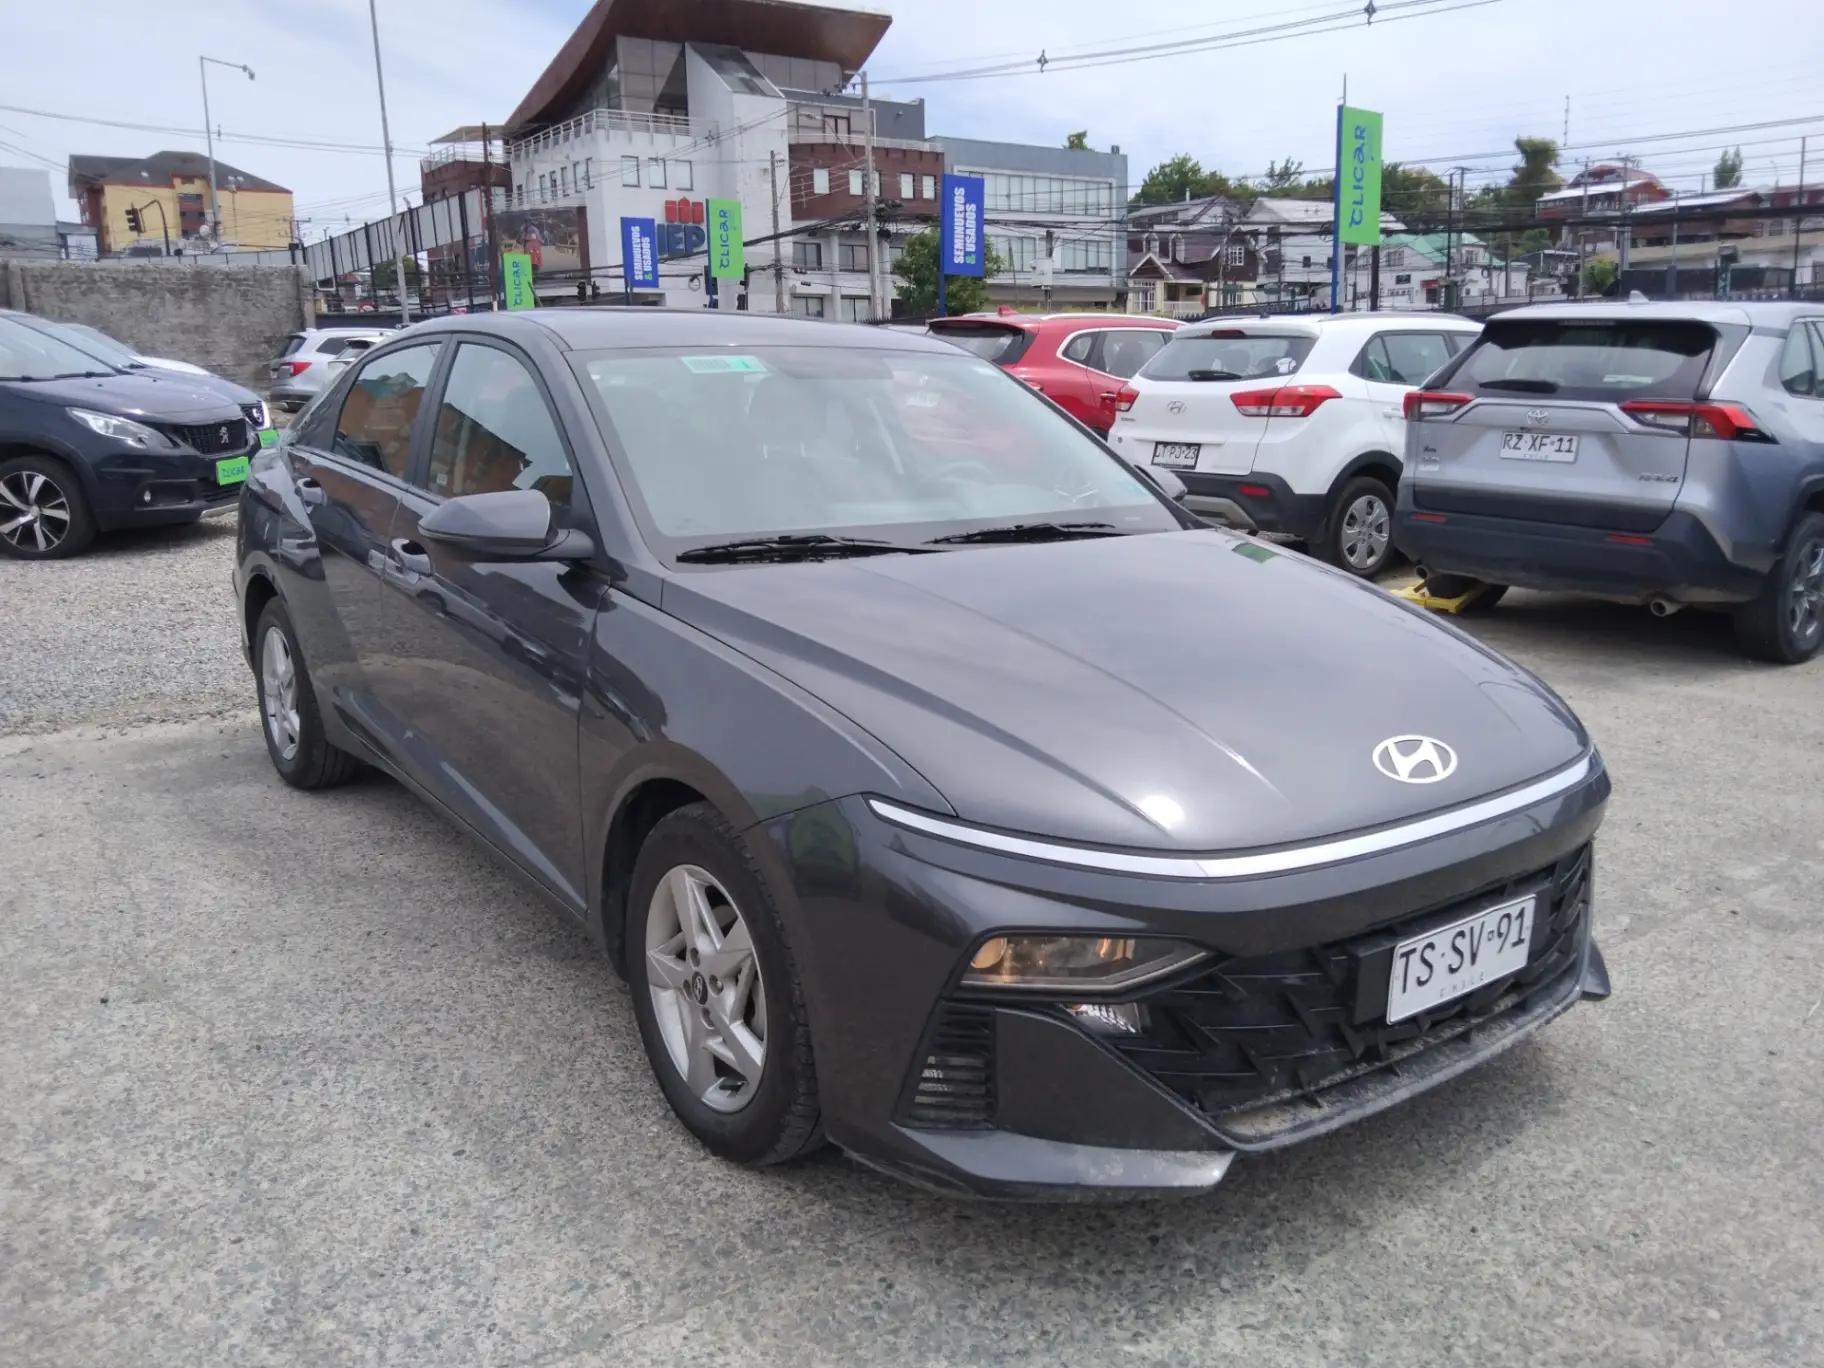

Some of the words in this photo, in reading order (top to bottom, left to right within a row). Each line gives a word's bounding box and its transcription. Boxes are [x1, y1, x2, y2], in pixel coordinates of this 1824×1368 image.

[954, 186, 965, 264] SEMINUEVOS
[965, 203, 977, 252] USADOS
[631, 226, 644, 281] SEMINUEVOS
[641, 236, 653, 272] USADOS
[965, 253, 976, 265] &
